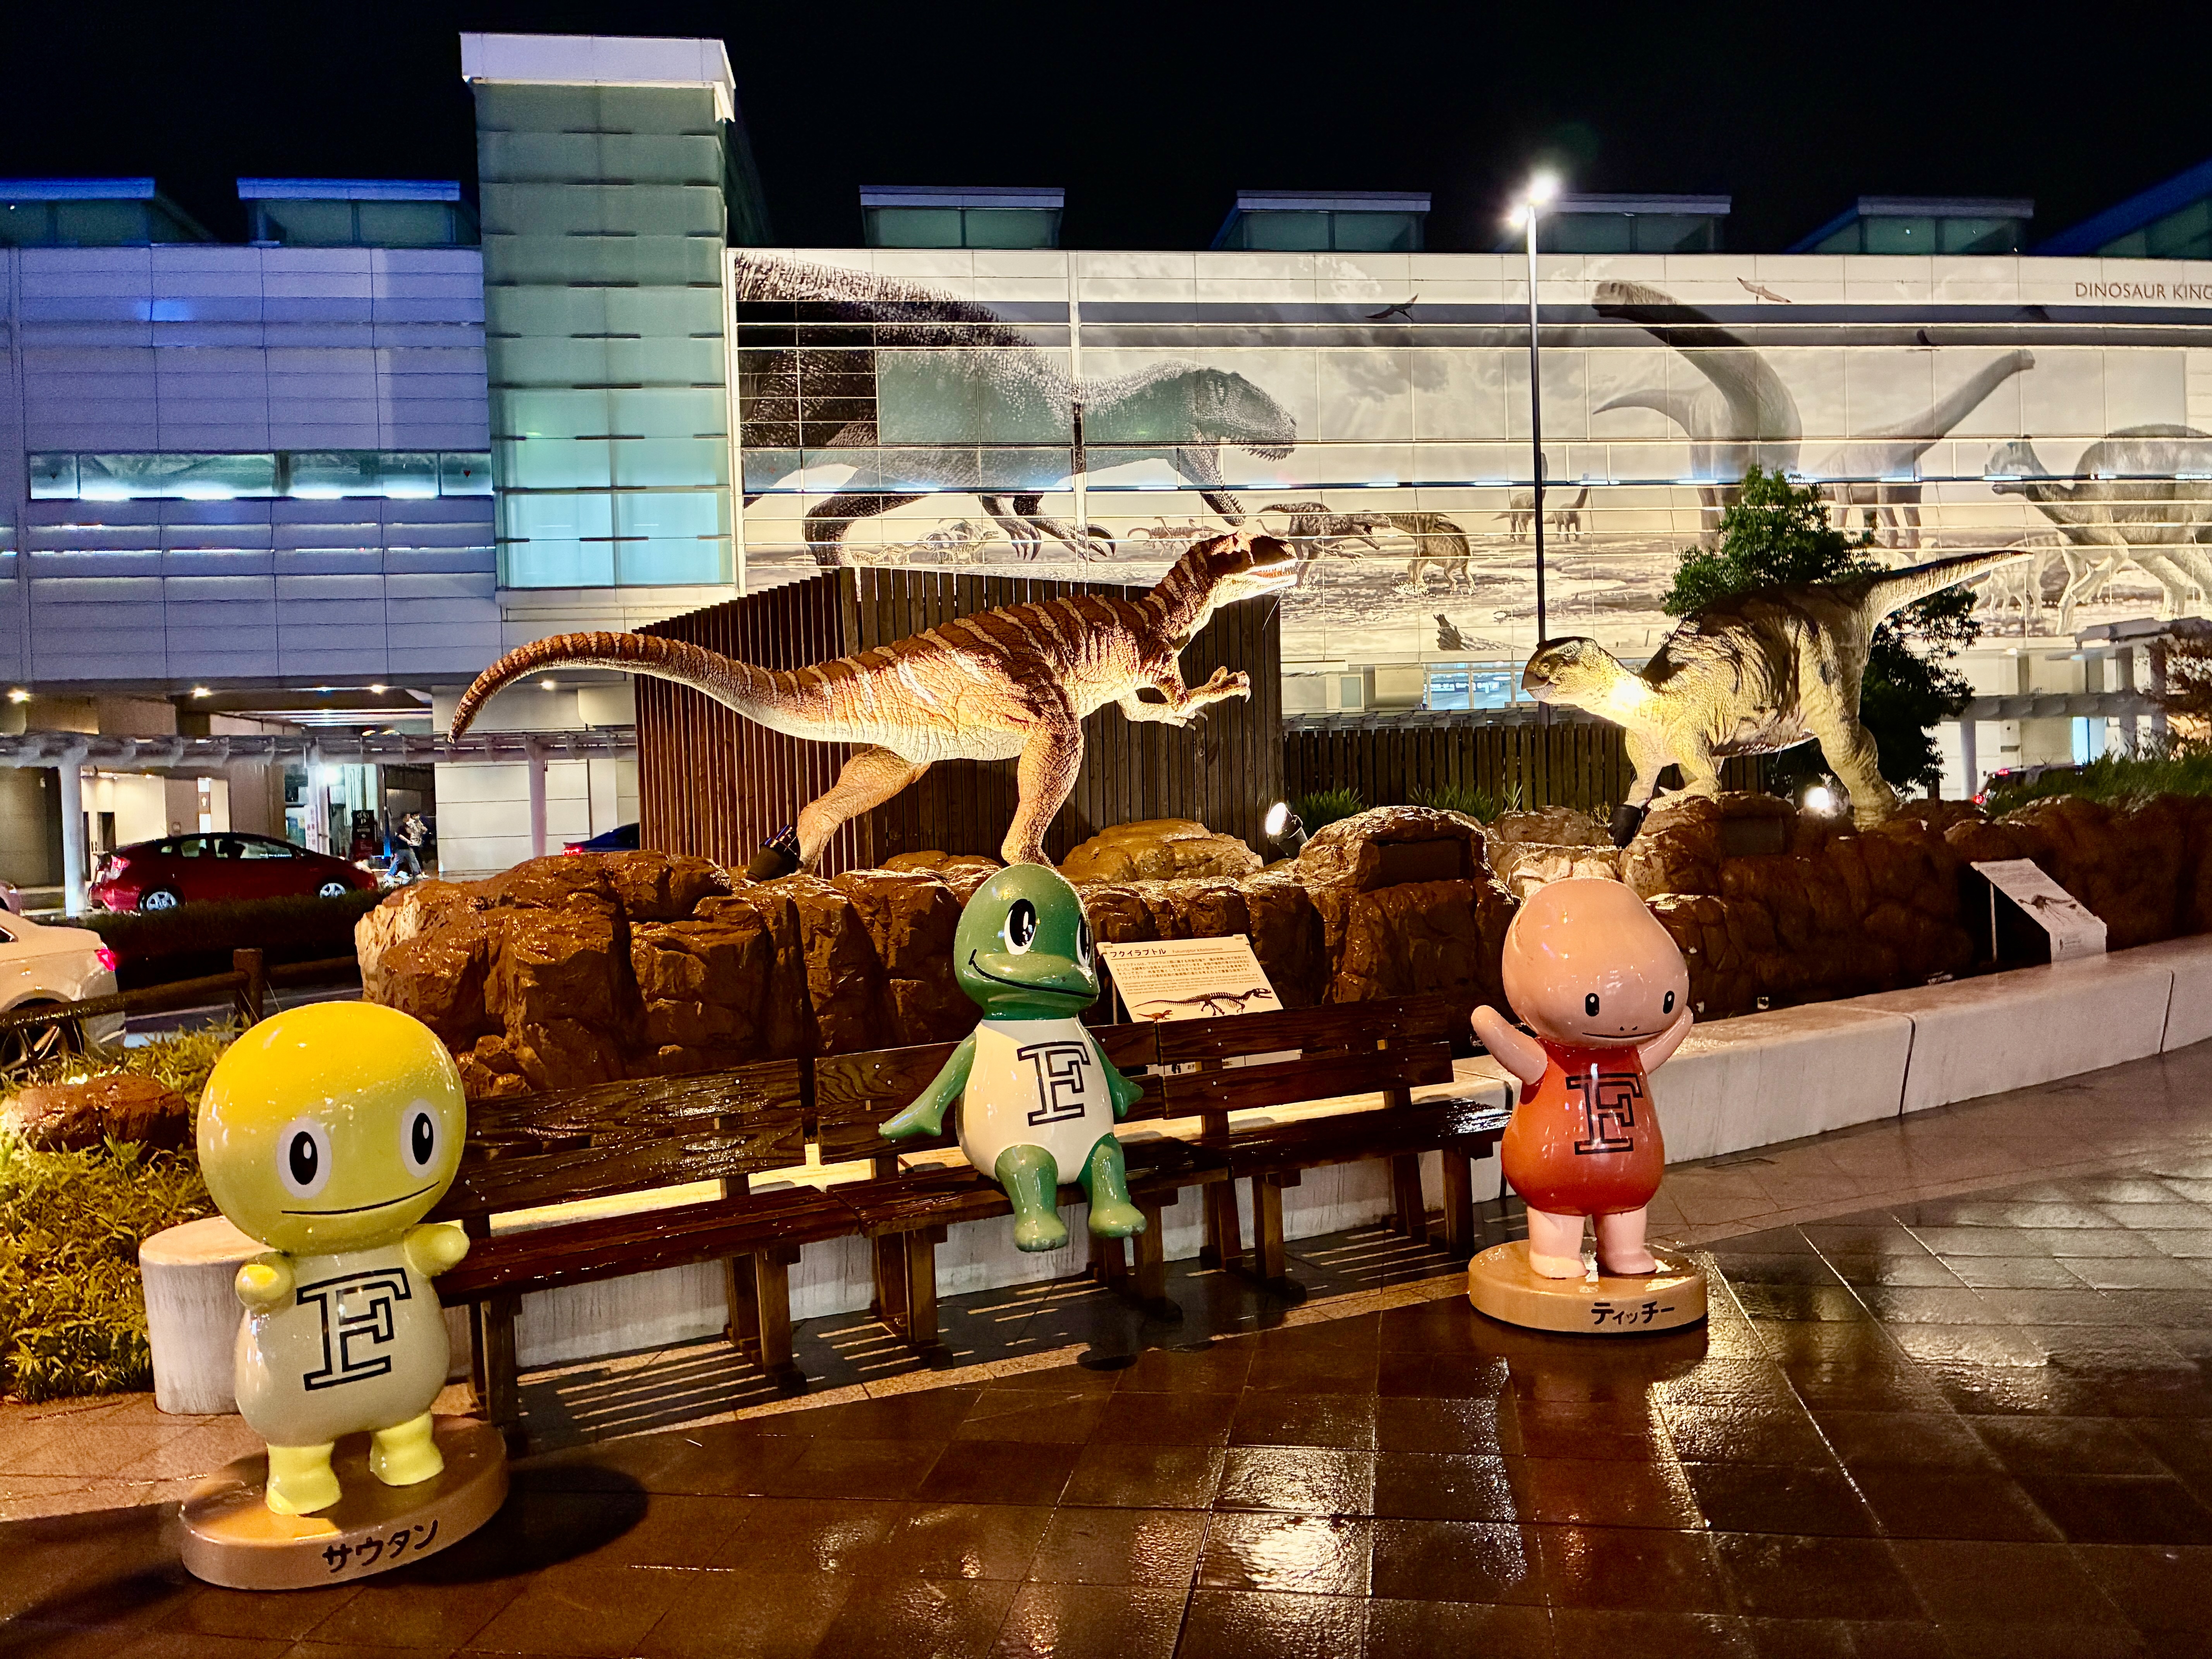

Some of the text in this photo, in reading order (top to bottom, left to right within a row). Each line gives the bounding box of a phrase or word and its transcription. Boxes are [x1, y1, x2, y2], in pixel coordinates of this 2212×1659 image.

[2075, 282, 2166, 300] DINOSAUR
[1017, 1041, 1091, 1126] F
[1566, 1072, 1643, 1155] F
[297, 1267, 412, 1391] F
[1591, 1301, 1675, 1324] ティッチー
[322, 1519, 438, 1573] サウタン
